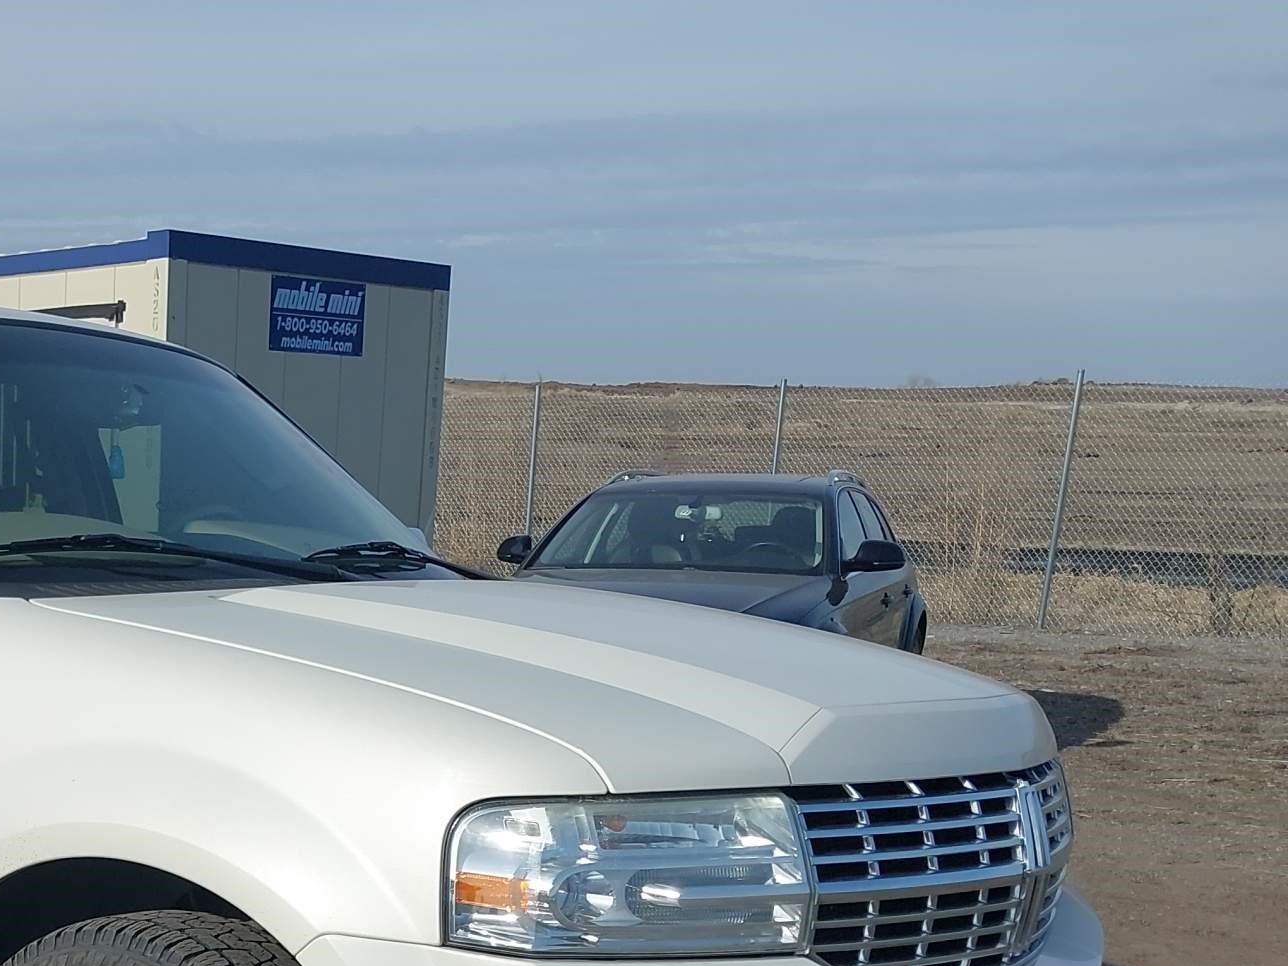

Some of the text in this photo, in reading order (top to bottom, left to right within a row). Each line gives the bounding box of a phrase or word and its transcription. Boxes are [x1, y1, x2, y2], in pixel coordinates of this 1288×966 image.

[273, 281, 364, 315] mobile mini
[277, 316, 358, 336] 1-800-950-6464
[280, 335, 353, 352] mobilemini.com
